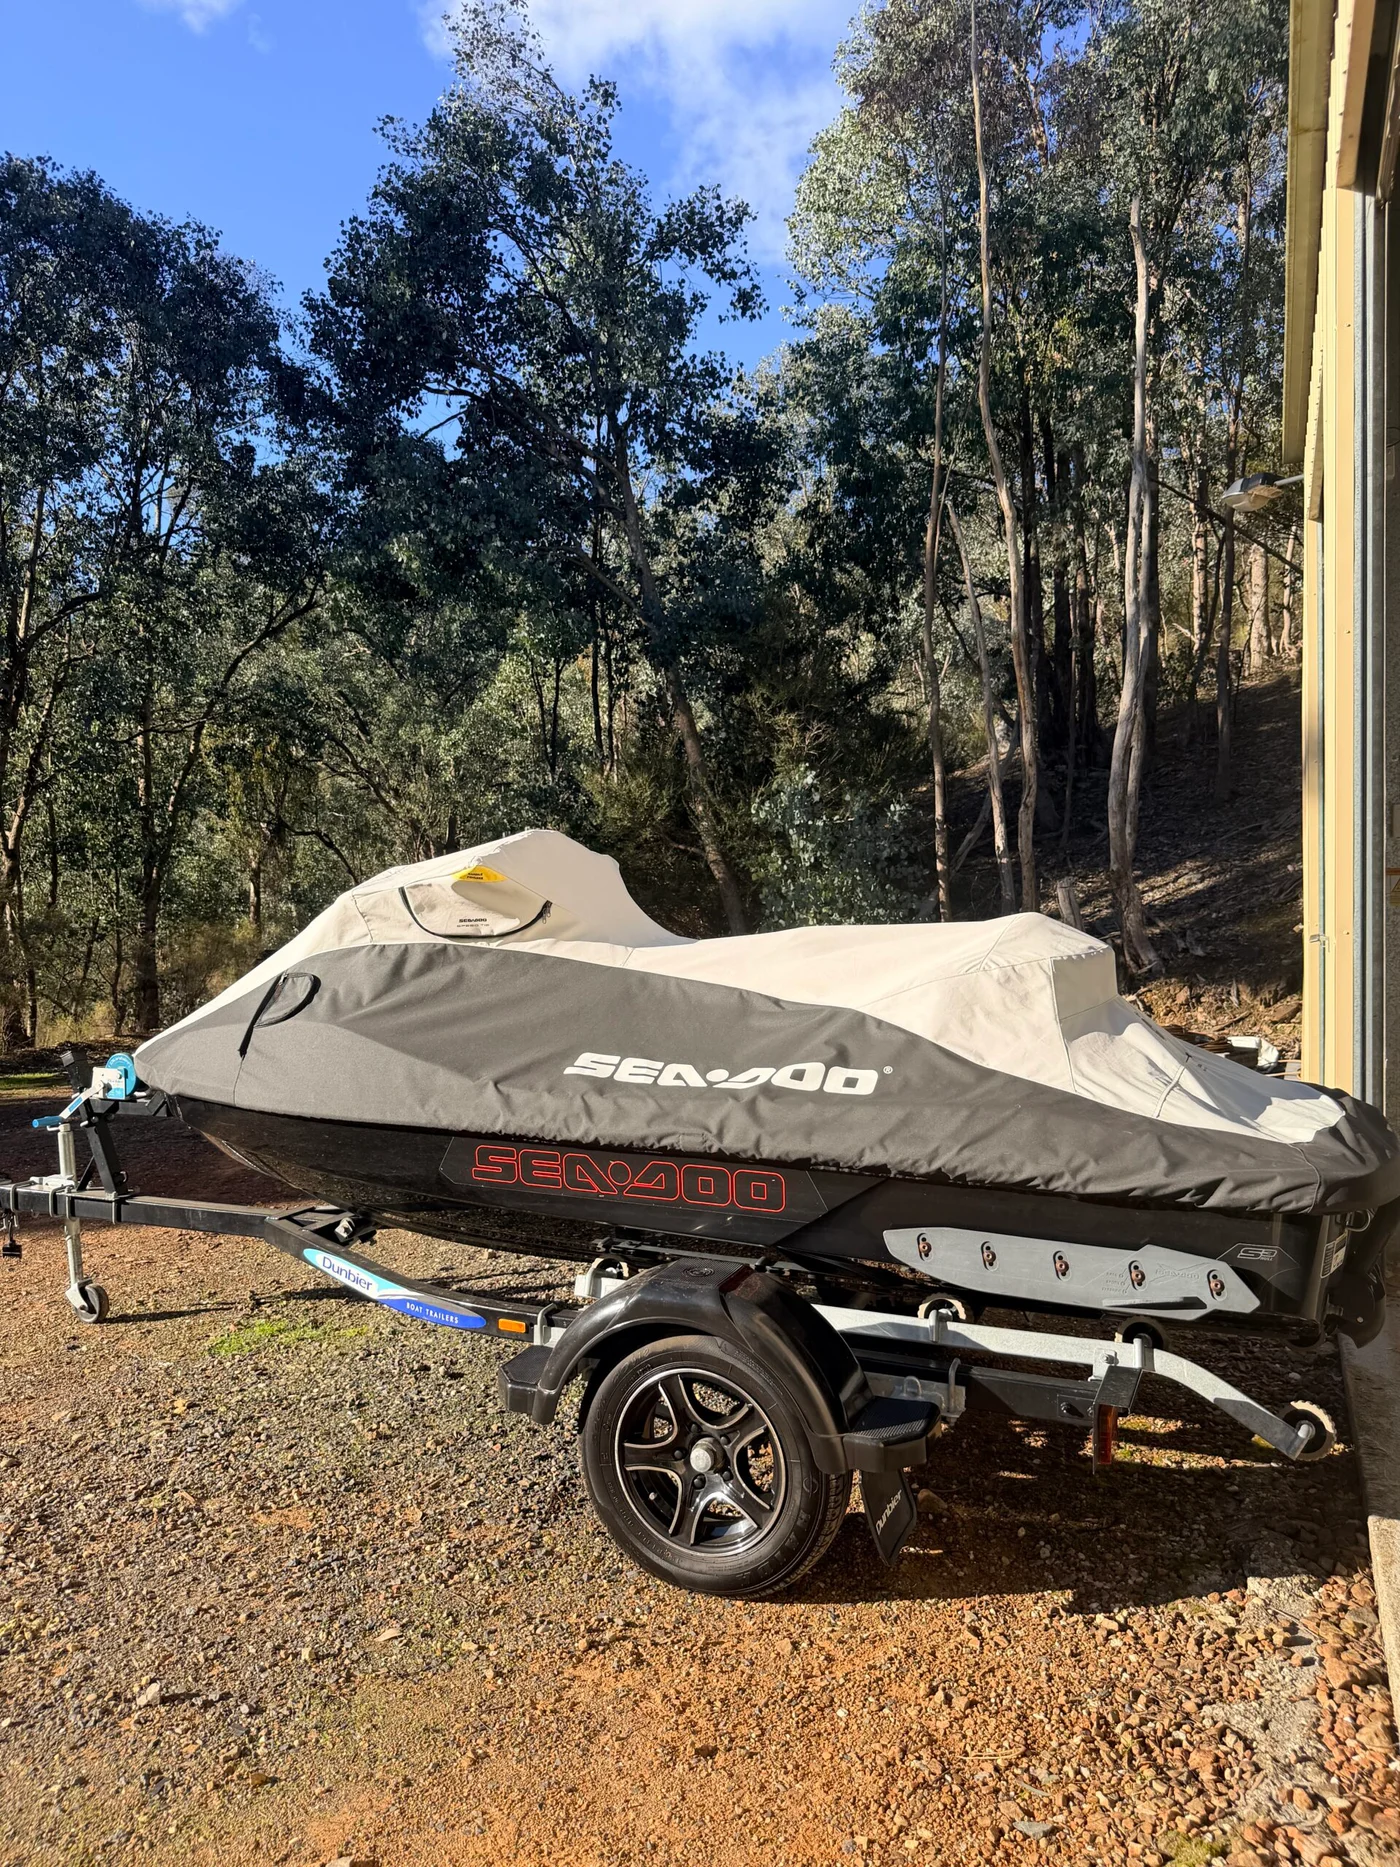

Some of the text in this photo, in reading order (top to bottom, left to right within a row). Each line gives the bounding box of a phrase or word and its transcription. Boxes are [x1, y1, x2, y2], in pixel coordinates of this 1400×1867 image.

[322, 1256, 373, 1291] Dunbier
[406, 1301, 459, 1324] BOAT TRAILERS
[875, 1489, 902, 1536] Dunbier
